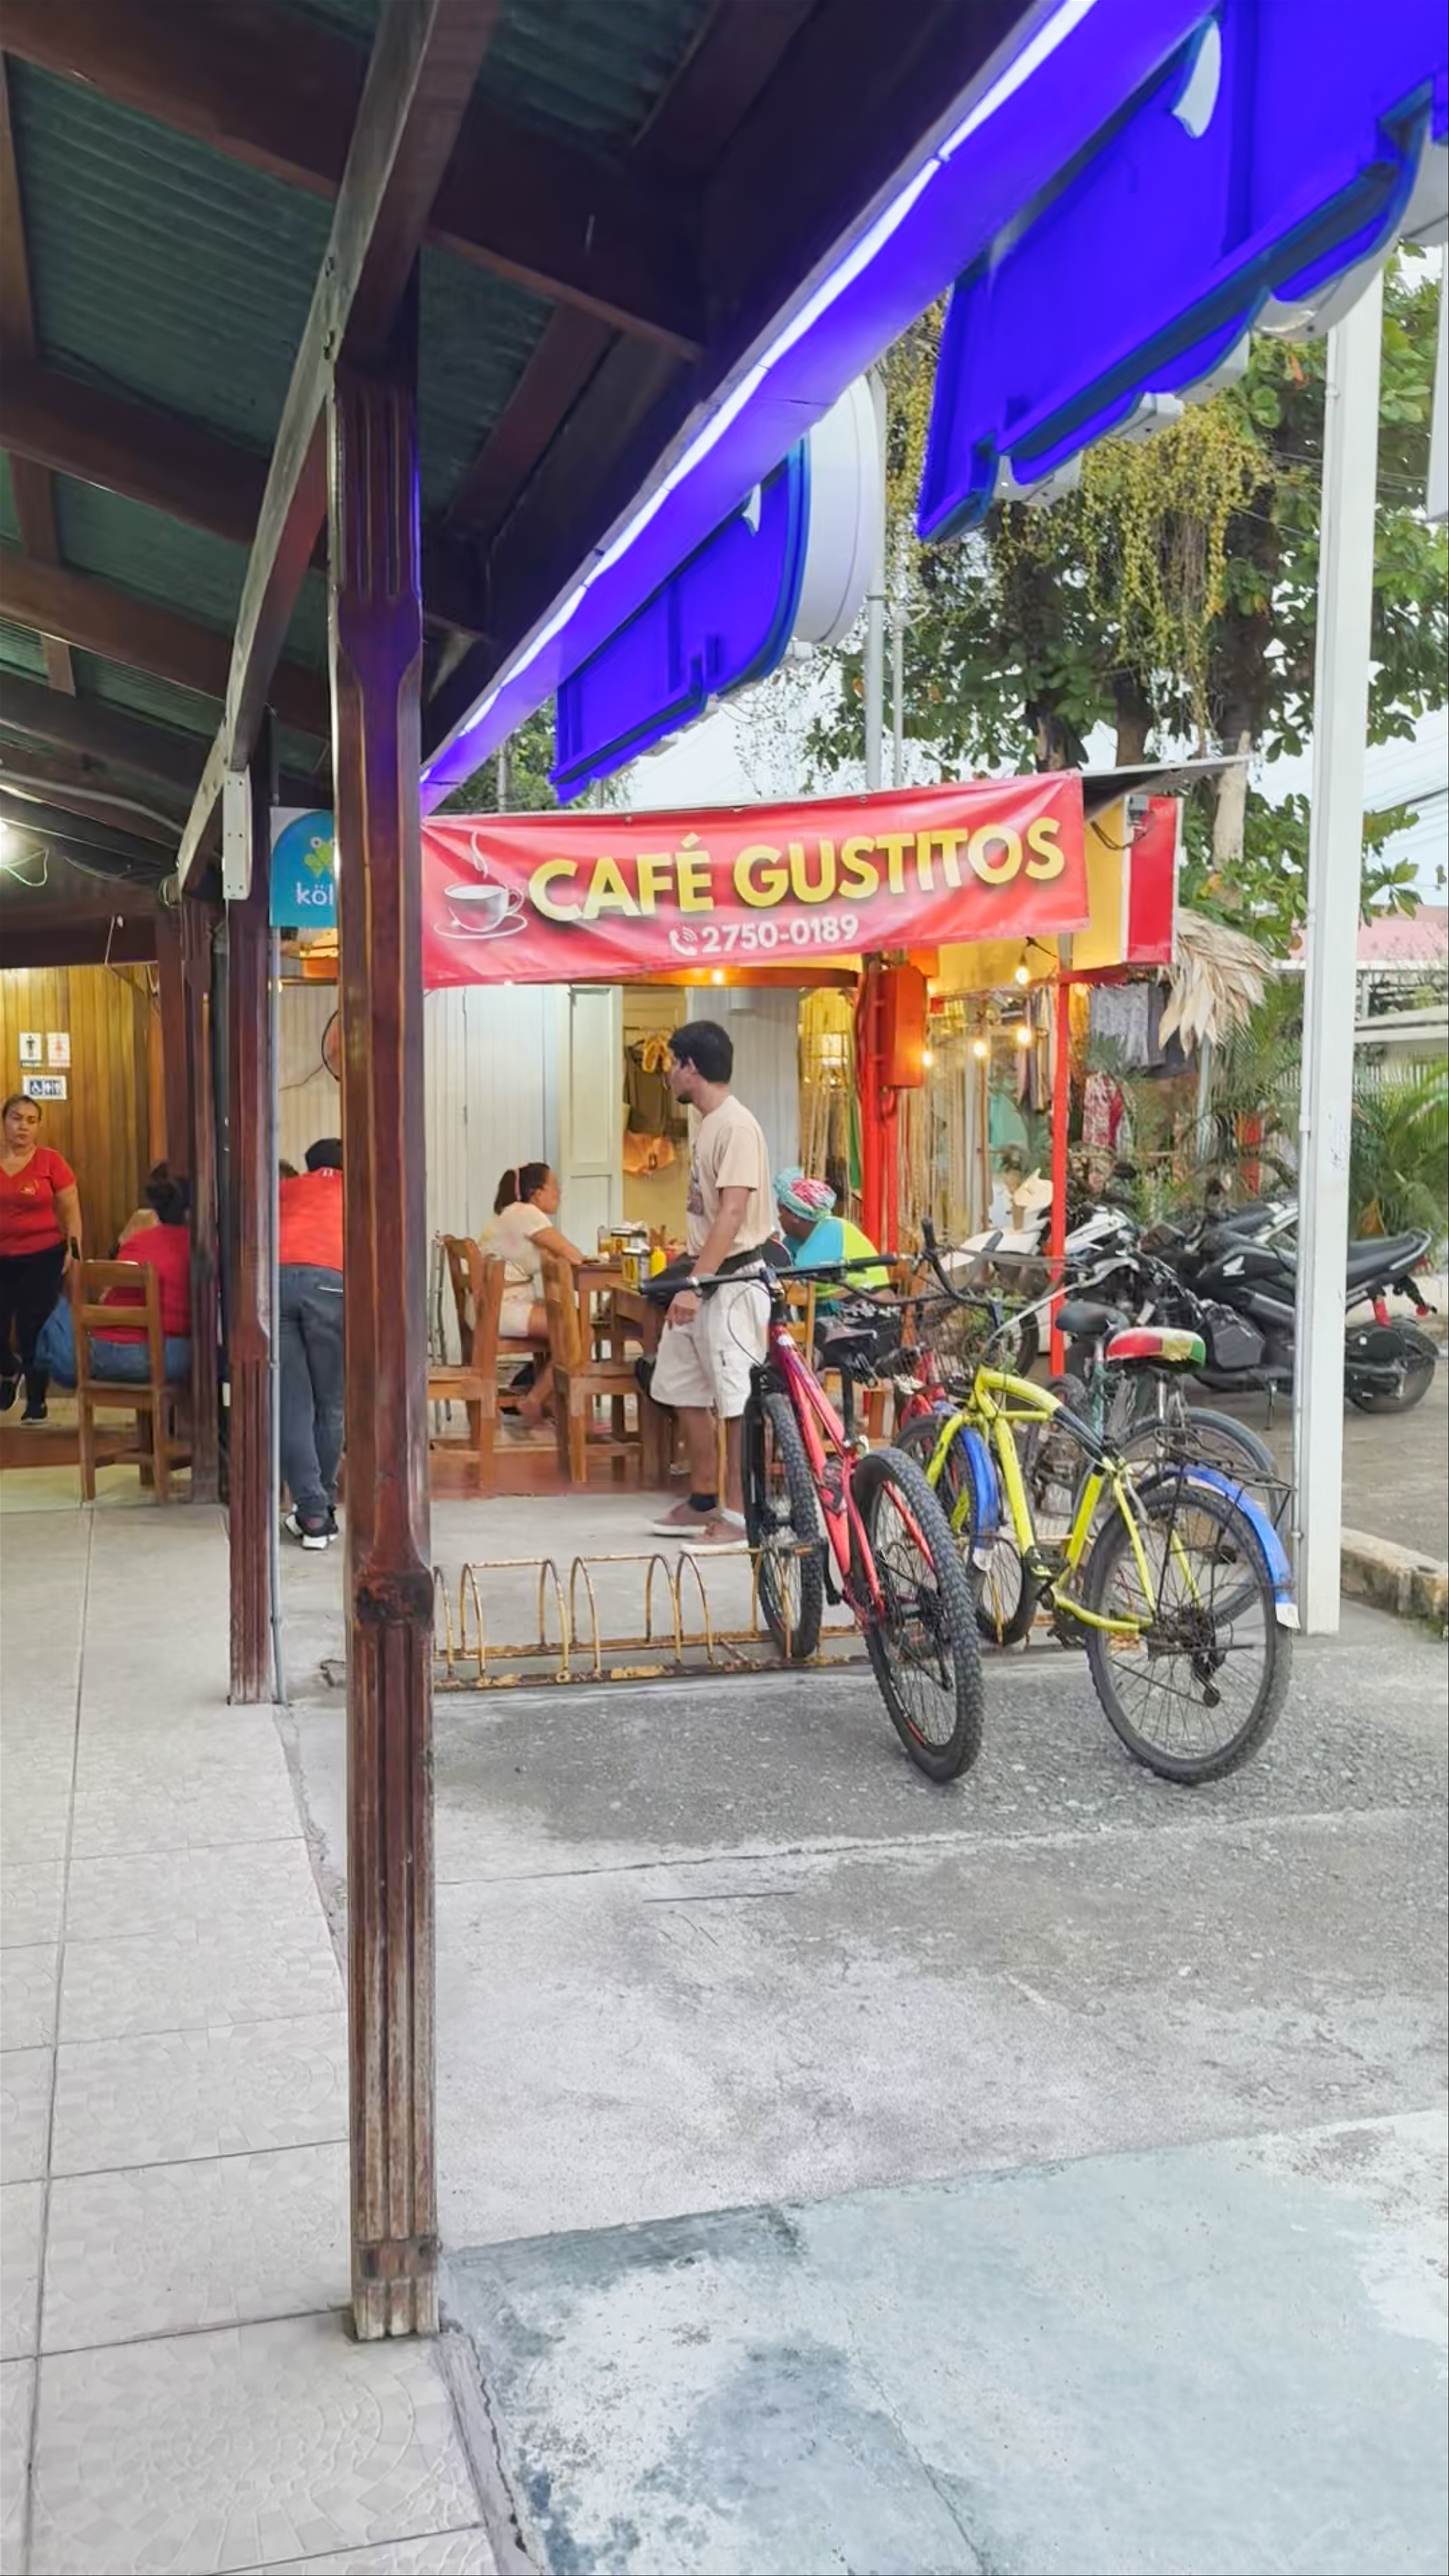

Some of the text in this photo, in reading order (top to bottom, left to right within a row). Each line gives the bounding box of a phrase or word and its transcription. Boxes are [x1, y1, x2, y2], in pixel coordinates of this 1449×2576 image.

[528, 817, 1065, 921] CAFÉ GUSTITOS
[701, 914, 859, 954] 2750-0189
